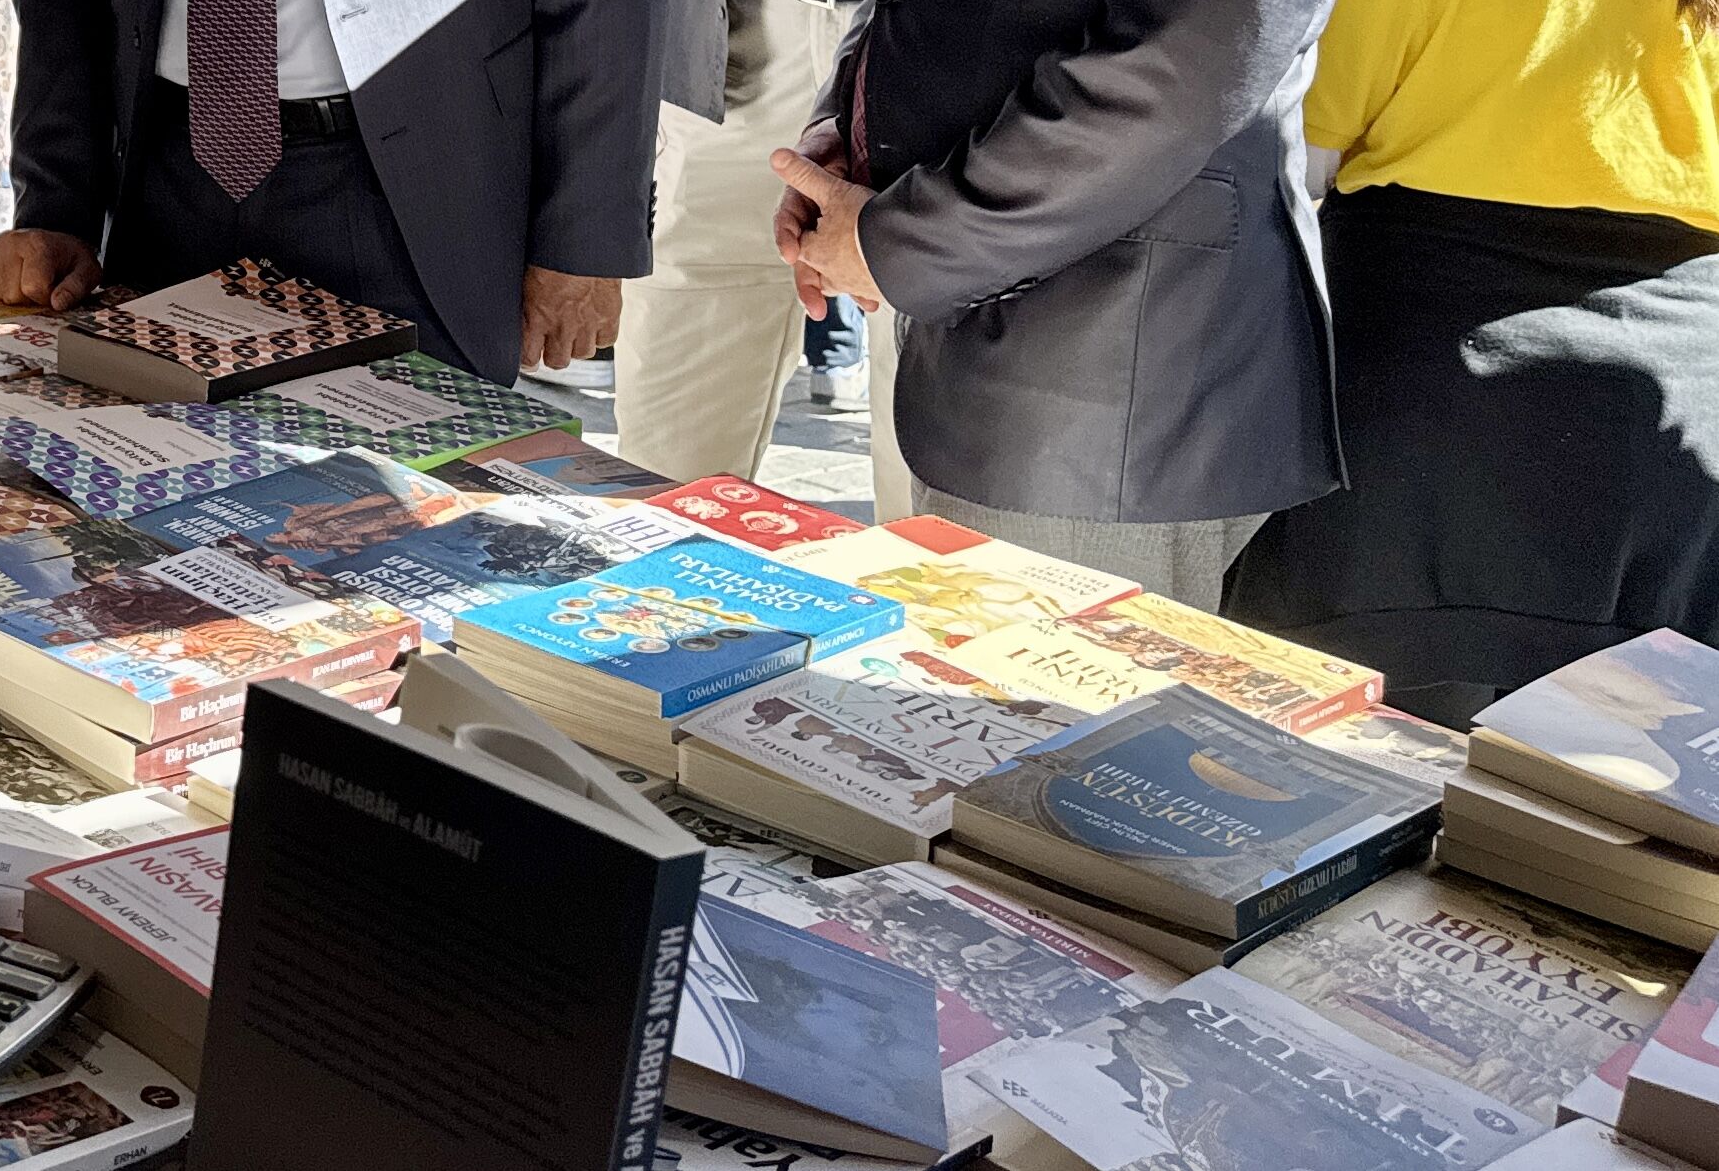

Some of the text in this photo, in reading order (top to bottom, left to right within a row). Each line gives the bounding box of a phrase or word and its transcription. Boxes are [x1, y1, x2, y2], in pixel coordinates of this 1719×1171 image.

[186, 514, 238, 539] SARAY
[666, 552, 847, 613] PADİŞAHLARI
[671, 570, 802, 613] OSMANLI
[686, 627, 866, 703] OSMANLI PADİŞAHLARI AFYONCU
[1006, 648, 1120, 703] MANLI
[179, 705, 196, 722] Bir
[166, 747, 183, 764] Bir
[917, 745, 987, 778] ÜYÜK
[130, 855, 223, 915] AVAŞIN
[66, 874, 178, 943] JEREMY BLACK
[647, 925, 686, 1016] HASAN
[112, 1145, 148, 1166] ERHAN
[623, 1127, 646, 1160] ve
